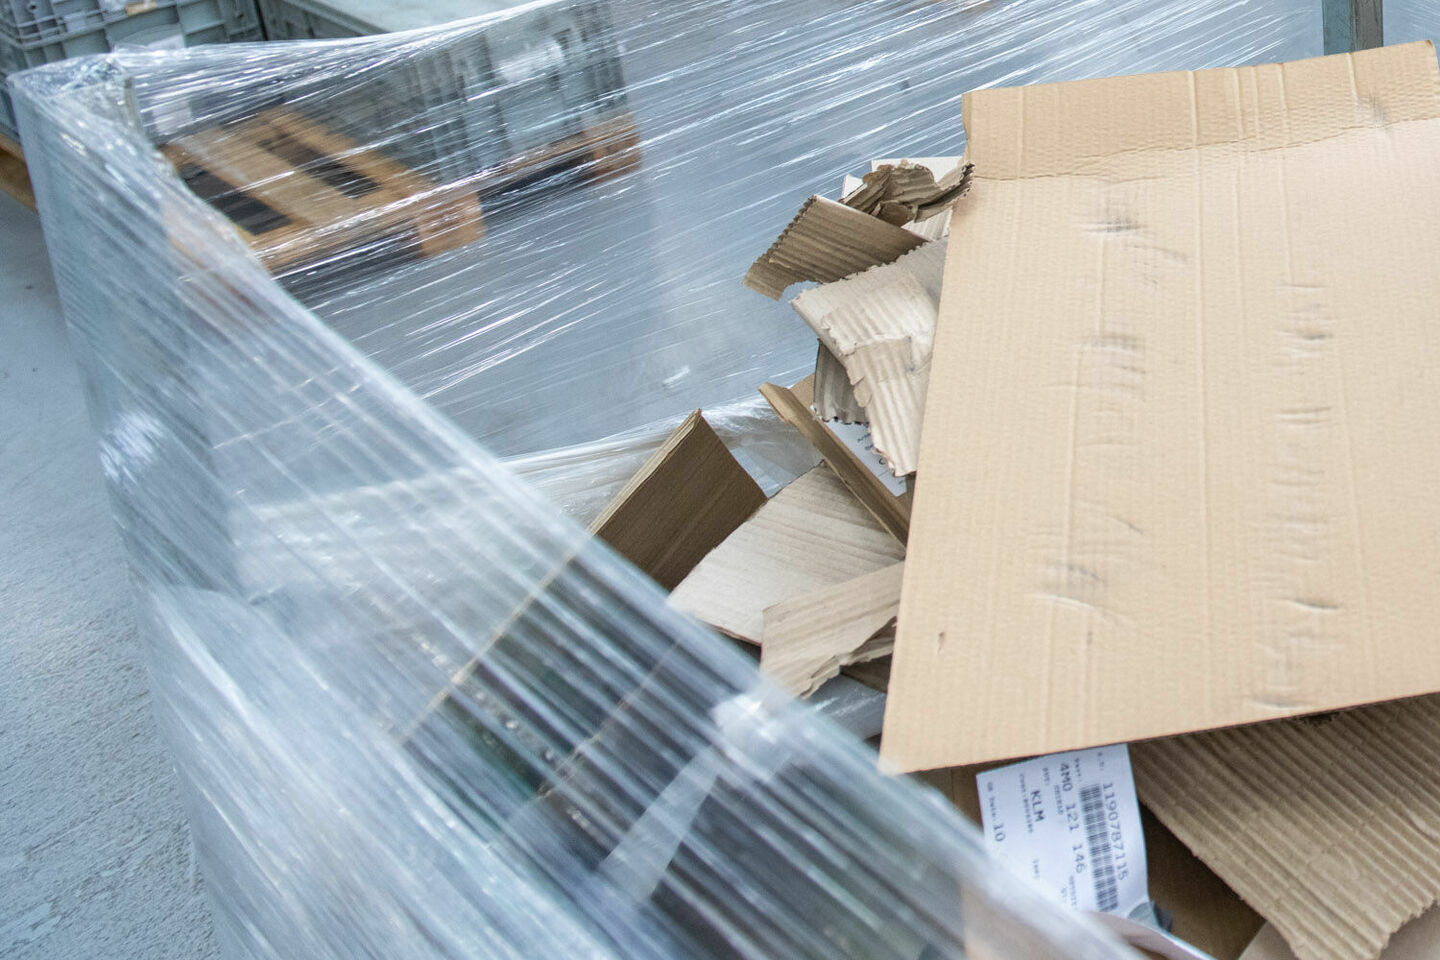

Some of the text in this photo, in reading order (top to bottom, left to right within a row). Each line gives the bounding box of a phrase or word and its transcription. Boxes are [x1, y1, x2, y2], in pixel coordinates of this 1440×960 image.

[1030, 789, 1045, 822] KLM
[1065, 803, 1080, 832] 121
[993, 822, 1006, 843] 10
[1102, 781, 1128, 881] 1190787115
[1071, 843, 1088, 874] 146
